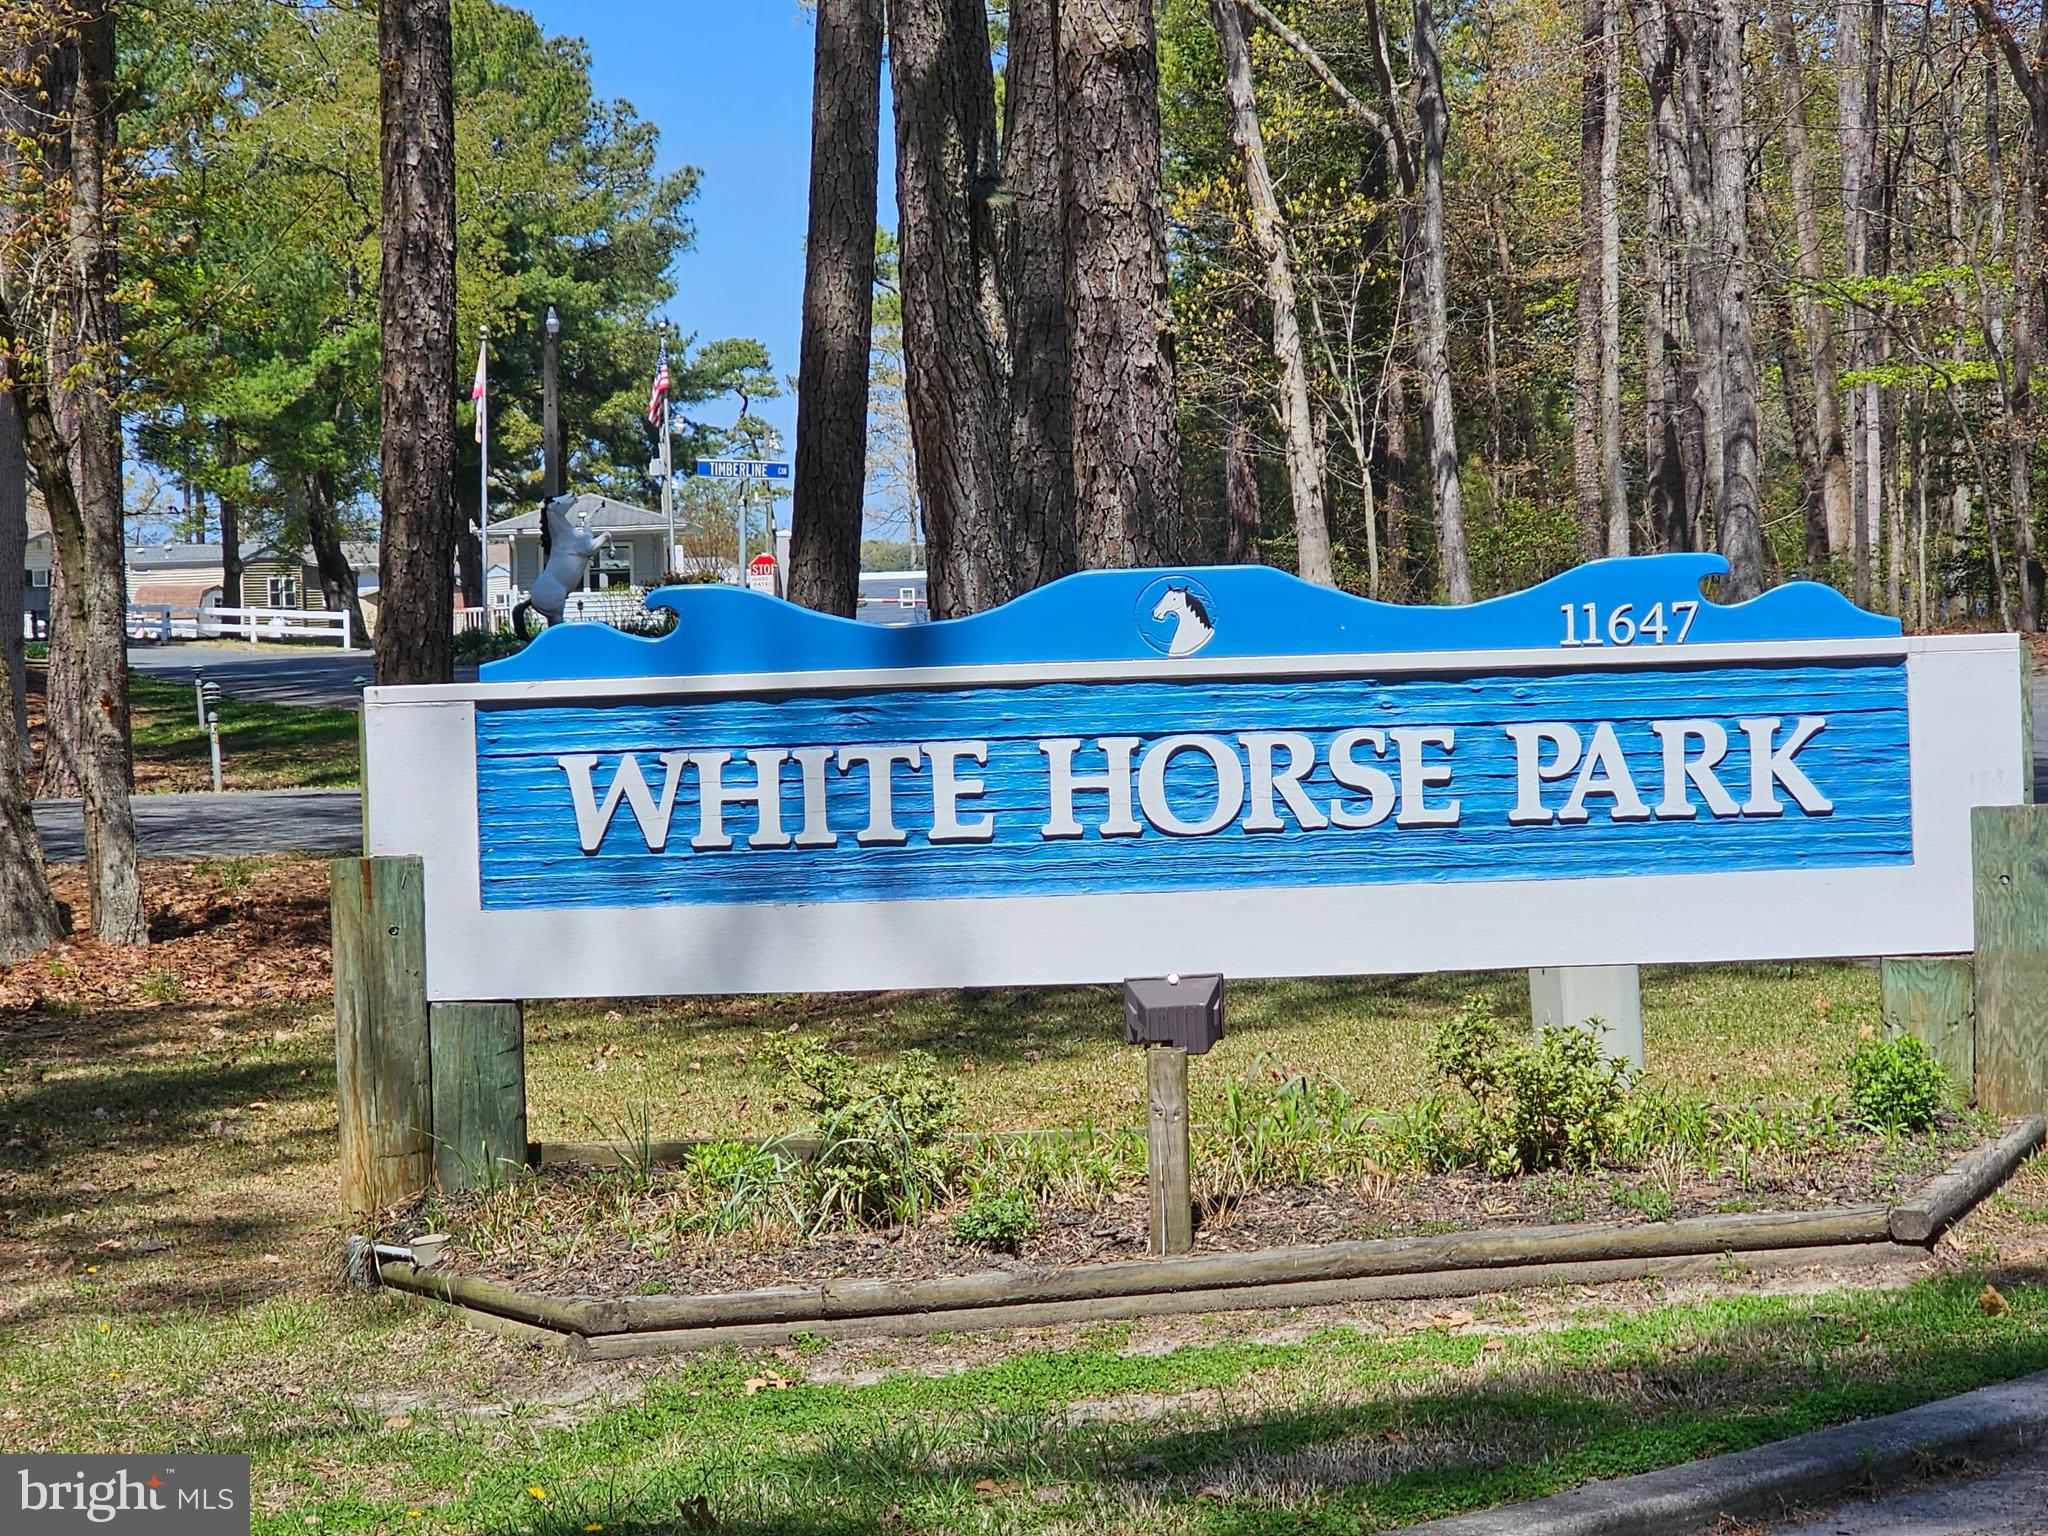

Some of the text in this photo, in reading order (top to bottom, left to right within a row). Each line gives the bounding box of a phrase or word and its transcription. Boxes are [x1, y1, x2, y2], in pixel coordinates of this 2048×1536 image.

[710, 462, 787, 477] TIMBERLINE CIR
[1560, 600, 1699, 646] 11647
[558, 716, 1835, 853] WHITE HORSE PARK
